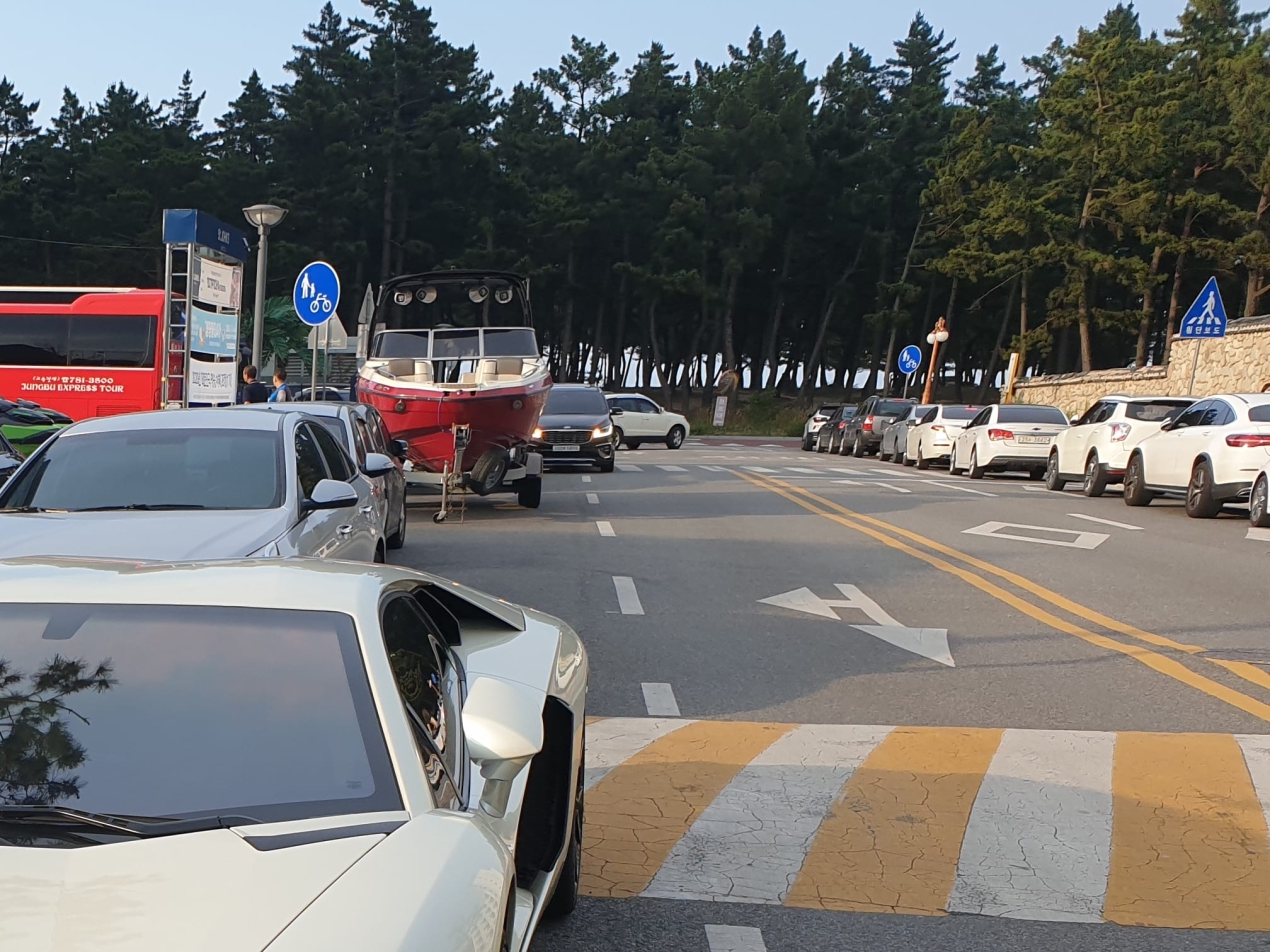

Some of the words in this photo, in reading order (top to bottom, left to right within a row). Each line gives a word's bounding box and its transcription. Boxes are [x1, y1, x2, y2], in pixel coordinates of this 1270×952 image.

[1186, 325, 1221, 335] 횡단보도
[69, 376, 114, 384] 781-3500
[21, 383, 56, 391] JUNGBU
[57, 383, 97, 392] EXPRESS
[99, 384, 124, 393] TOUR
